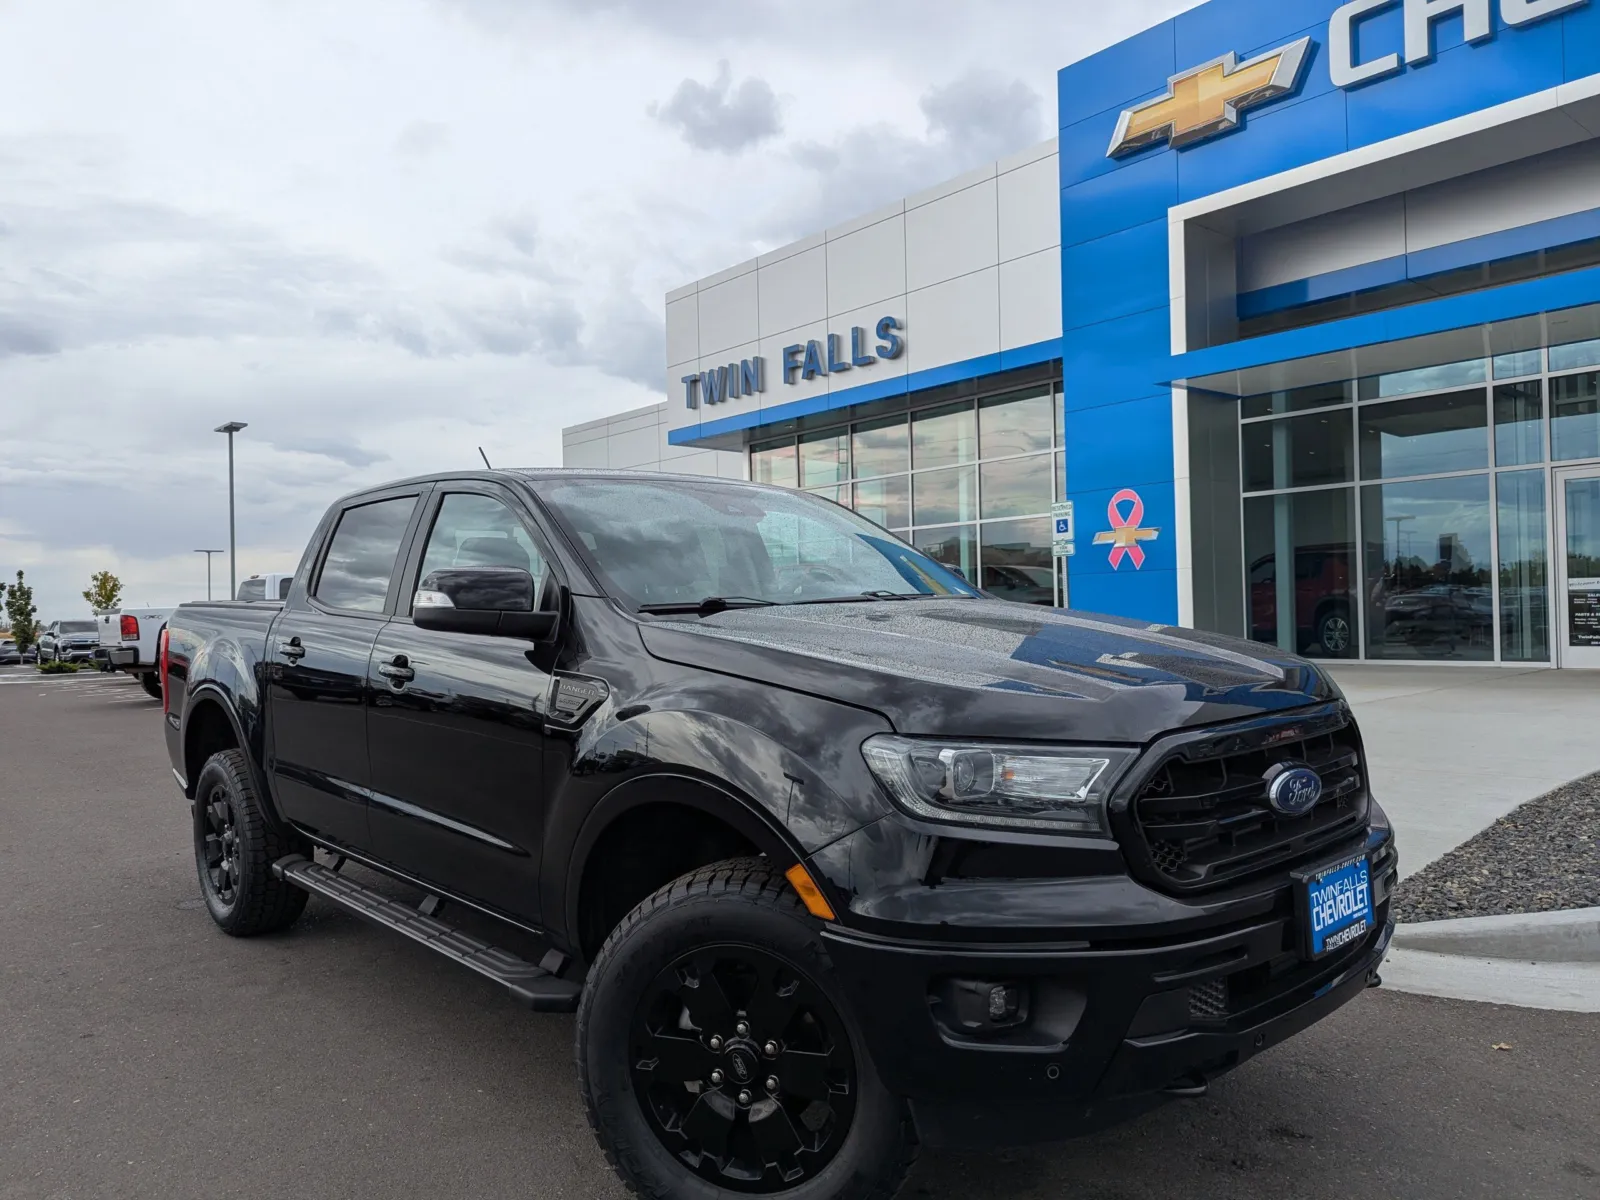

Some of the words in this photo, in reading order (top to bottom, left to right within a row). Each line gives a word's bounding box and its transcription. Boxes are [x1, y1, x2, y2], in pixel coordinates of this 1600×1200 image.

[681, 356, 764, 410] TWIN
[782, 316, 905, 385] FALLS
[559, 683, 595, 696] RANGER
[1288, 776, 1316, 805] Ford
[1312, 883, 1368, 932] CHEVROLET
[1338, 919, 1367, 945] CHEVROLET
